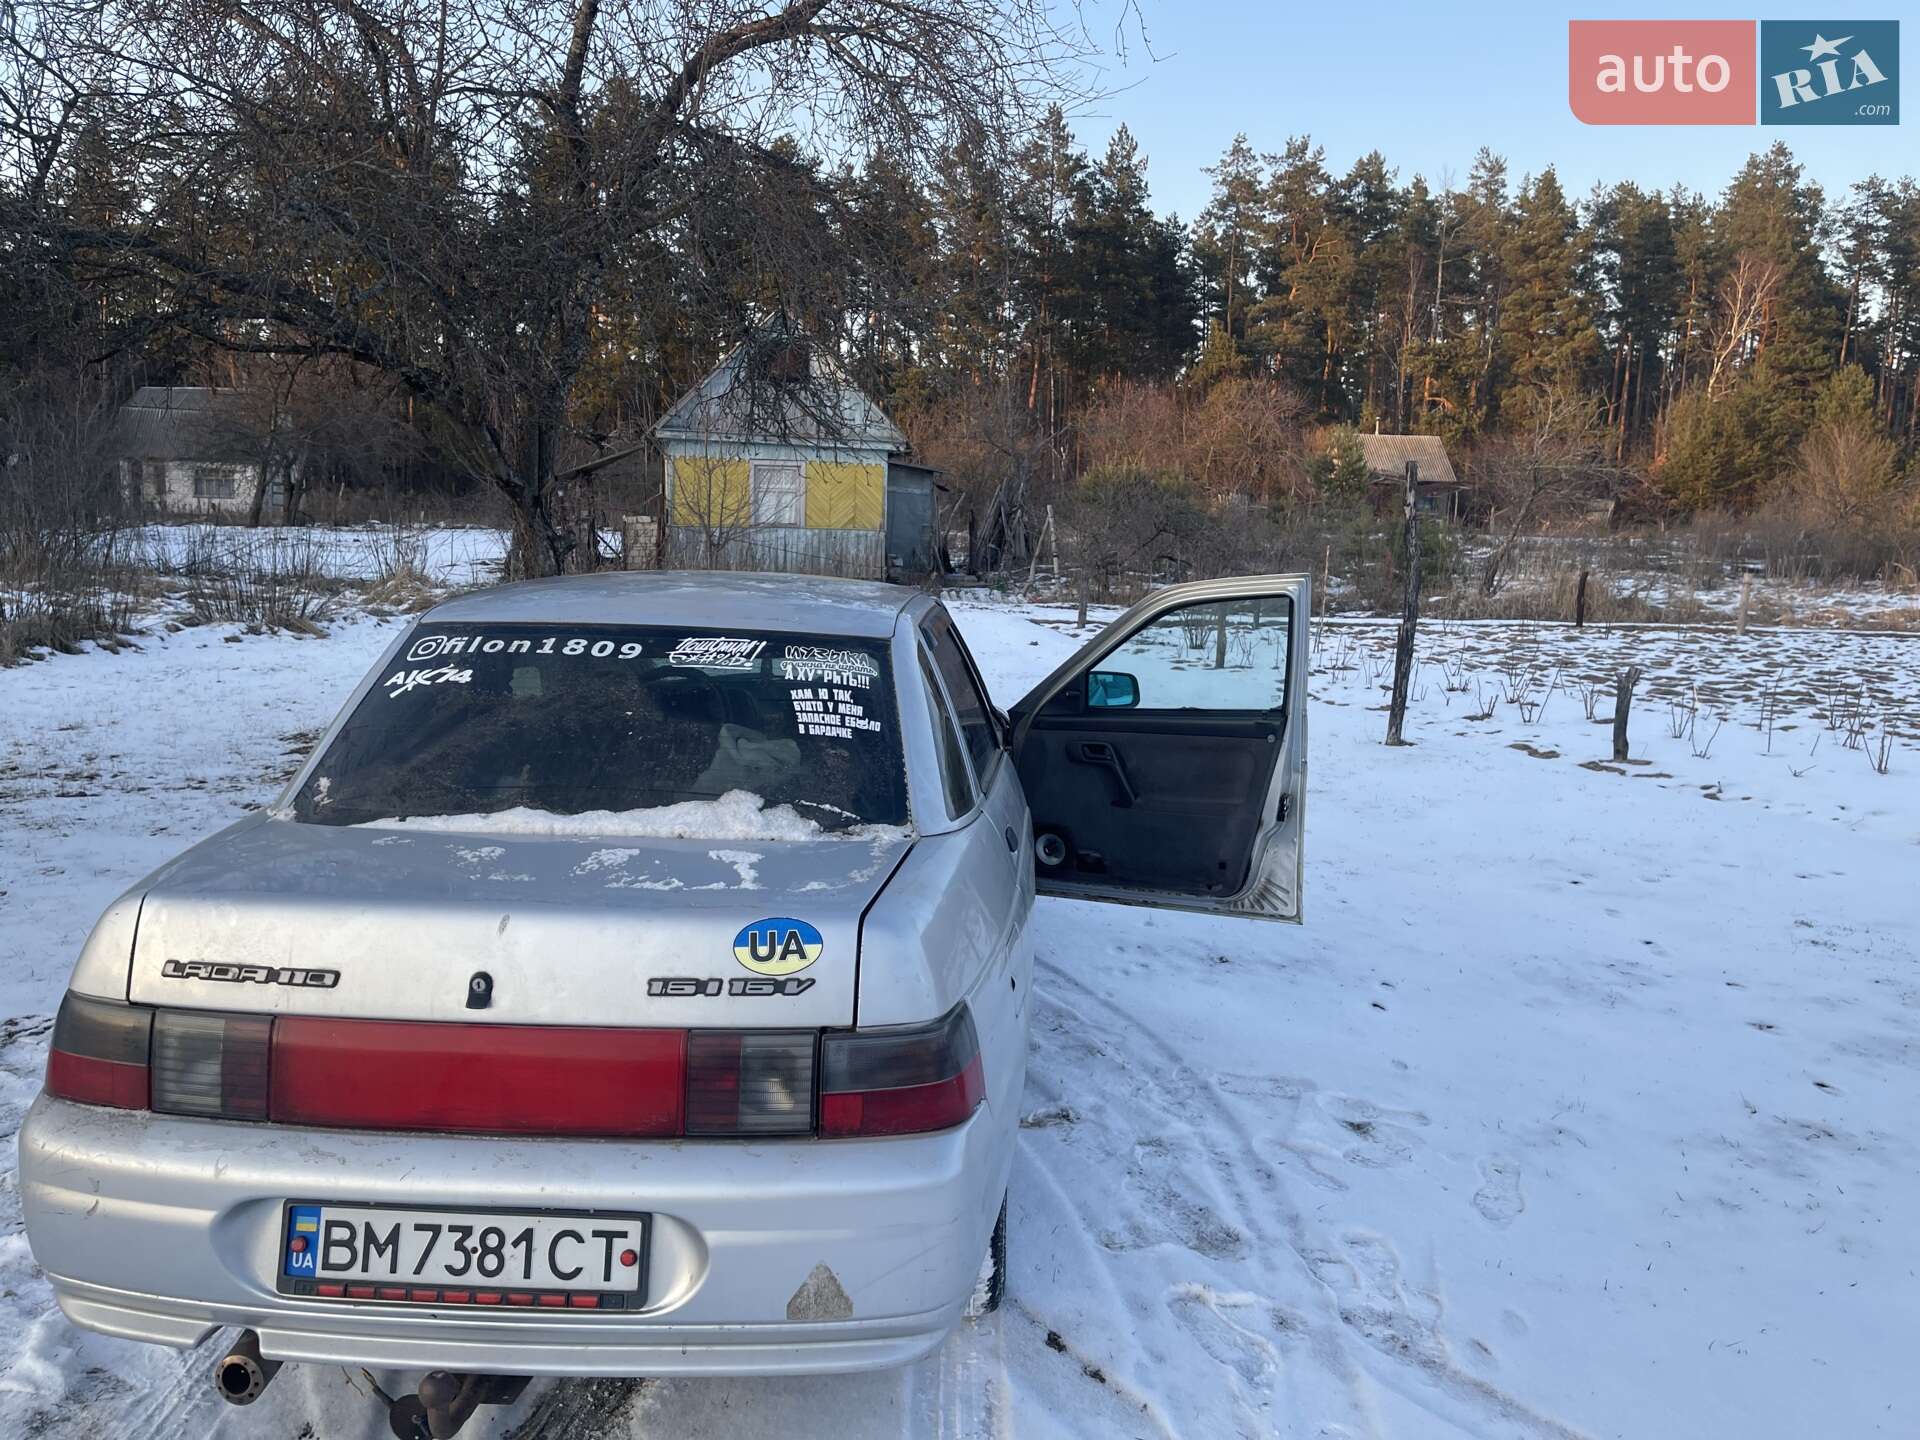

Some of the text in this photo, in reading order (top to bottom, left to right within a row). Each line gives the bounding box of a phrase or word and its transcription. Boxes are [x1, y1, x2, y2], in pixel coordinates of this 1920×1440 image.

[441, 636, 643, 659] filon1809
[790, 688, 853, 703] ХАМ Ю ТАК,
[793, 701, 863, 717] БУДТО У МЕНЯ
[796, 712, 841, 725] ЗАПАСНОЕ
[798, 723, 853, 739] В БАРДАЧКЕ
[750, 930, 808, 962] UA
[163, 961, 338, 987] LADA 110
[292, 1252, 313, 1269] UA
